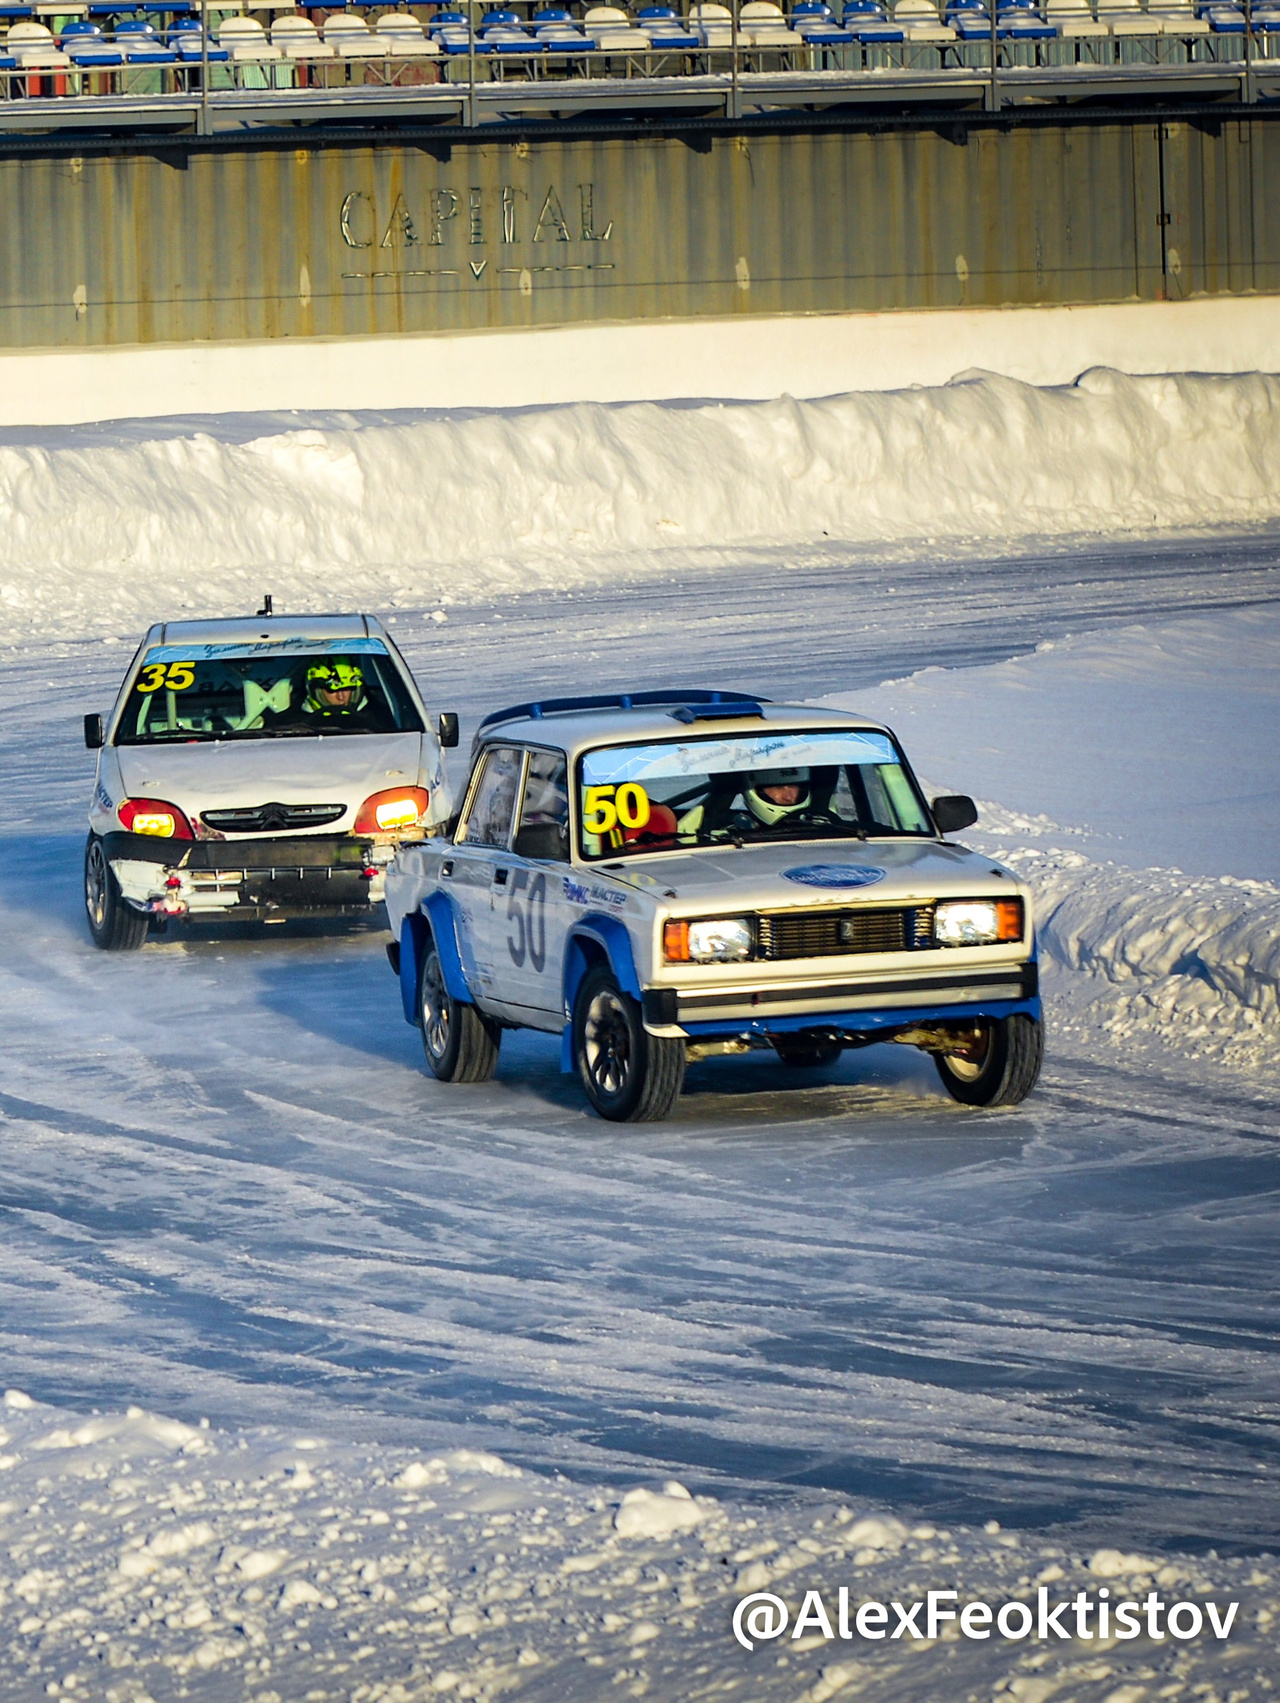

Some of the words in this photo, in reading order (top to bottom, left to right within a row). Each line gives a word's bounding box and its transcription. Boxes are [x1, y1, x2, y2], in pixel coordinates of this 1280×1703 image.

[340, 183, 614, 249] CAPITAL
[137, 661, 196, 693] 35
[583, 782, 651, 835] 50
[506, 868, 546, 974] 50
